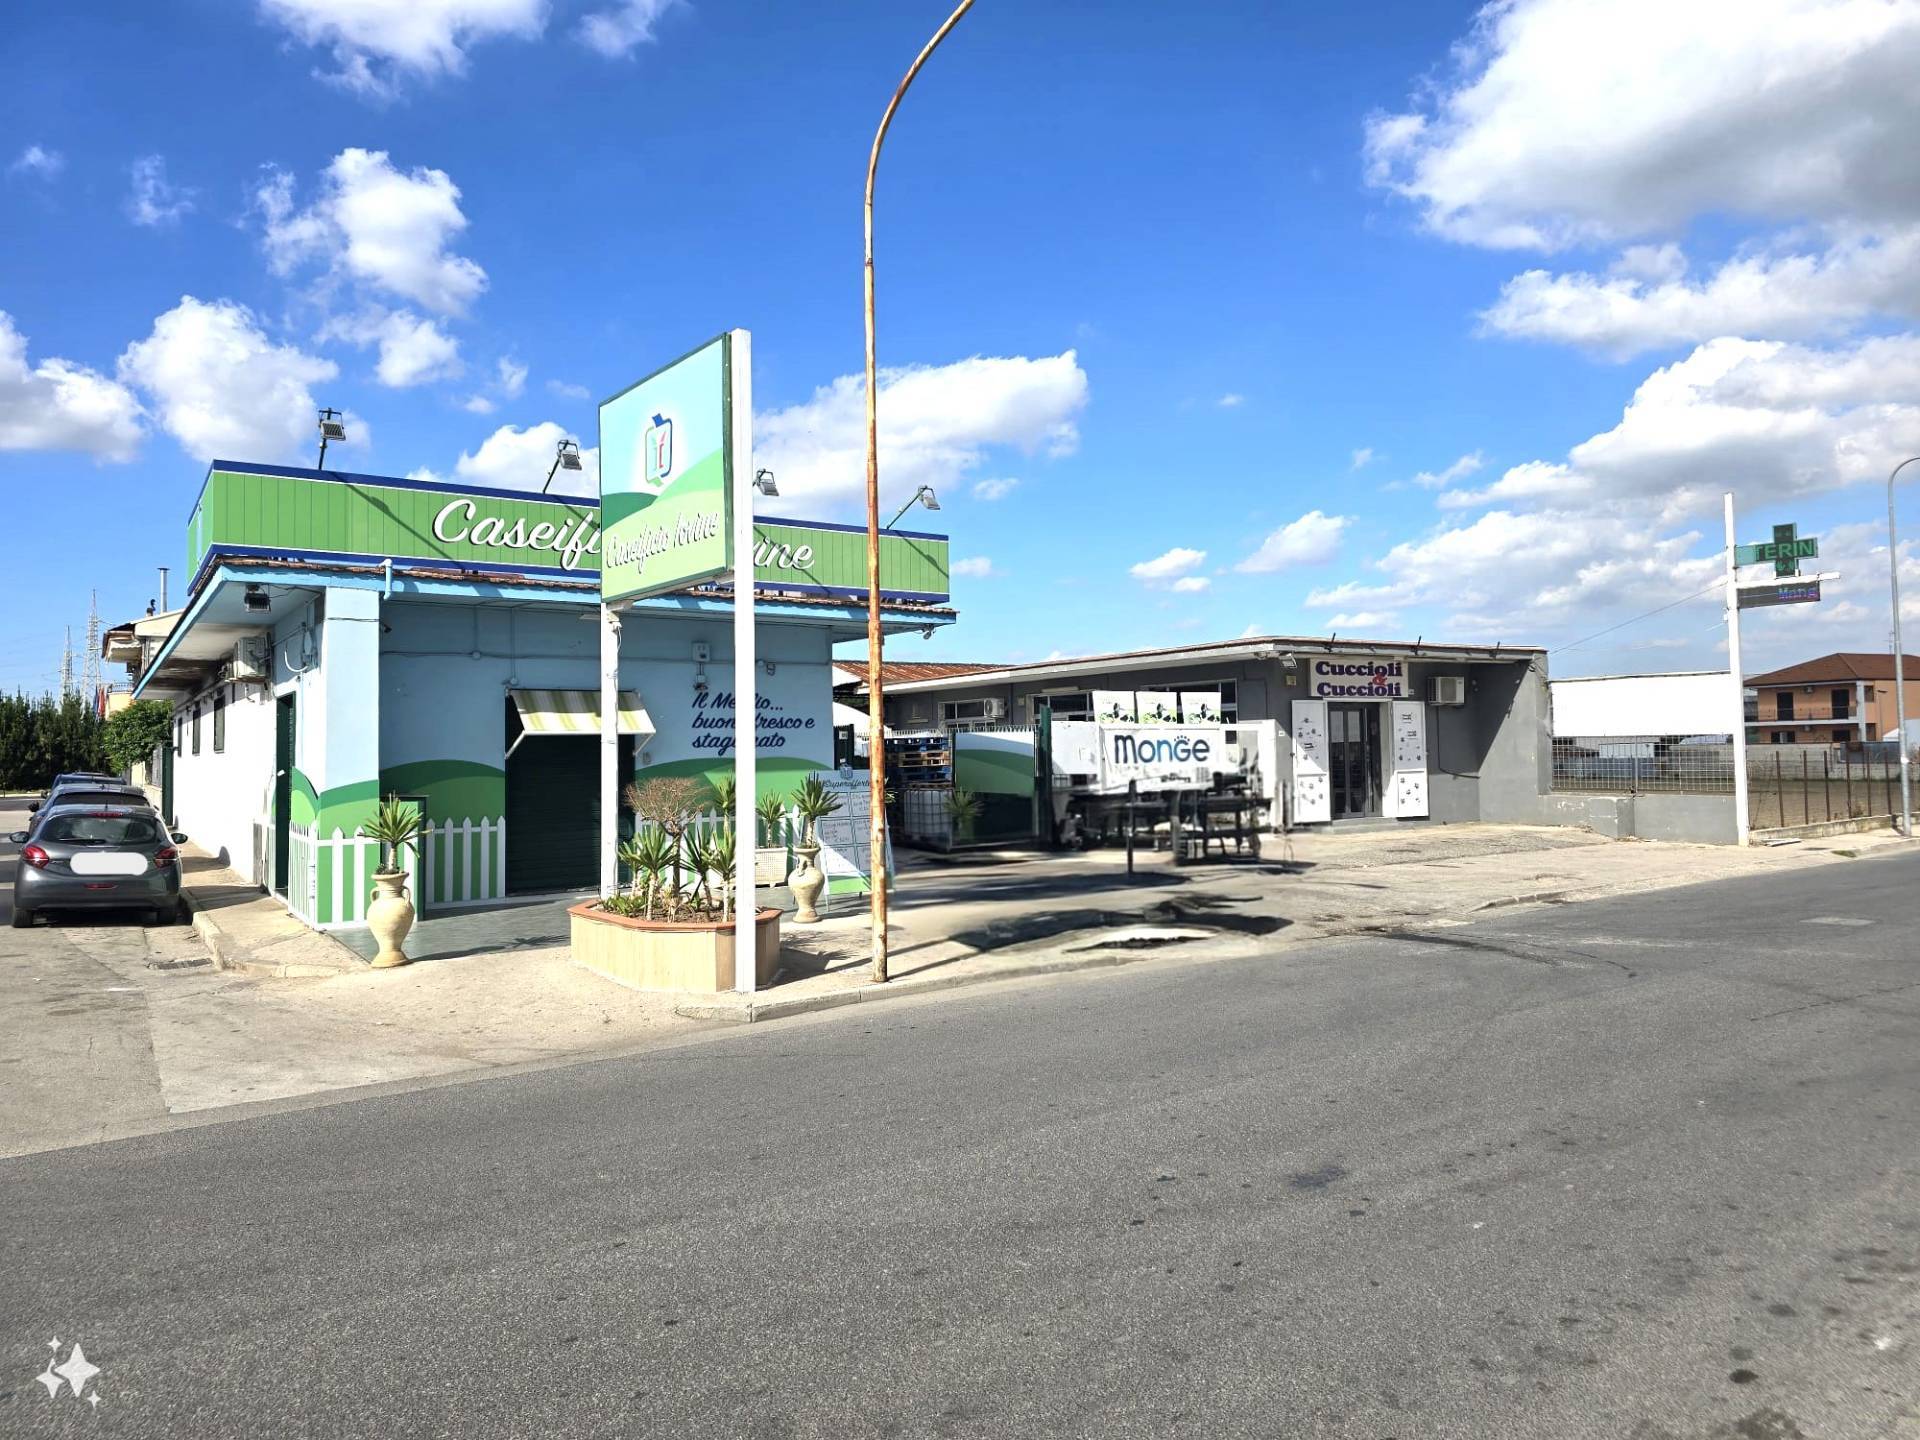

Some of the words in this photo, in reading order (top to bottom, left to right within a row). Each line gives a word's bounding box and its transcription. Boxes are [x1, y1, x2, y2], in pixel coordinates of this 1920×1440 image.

[432, 498, 600, 571] Caseifi
[1315, 661, 1402, 677] Cuccioli
[1316, 682, 1402, 697] Cuccioli
[692, 692, 708, 709] Il
[692, 711, 736, 729] buon
[804, 718, 816, 729] e
